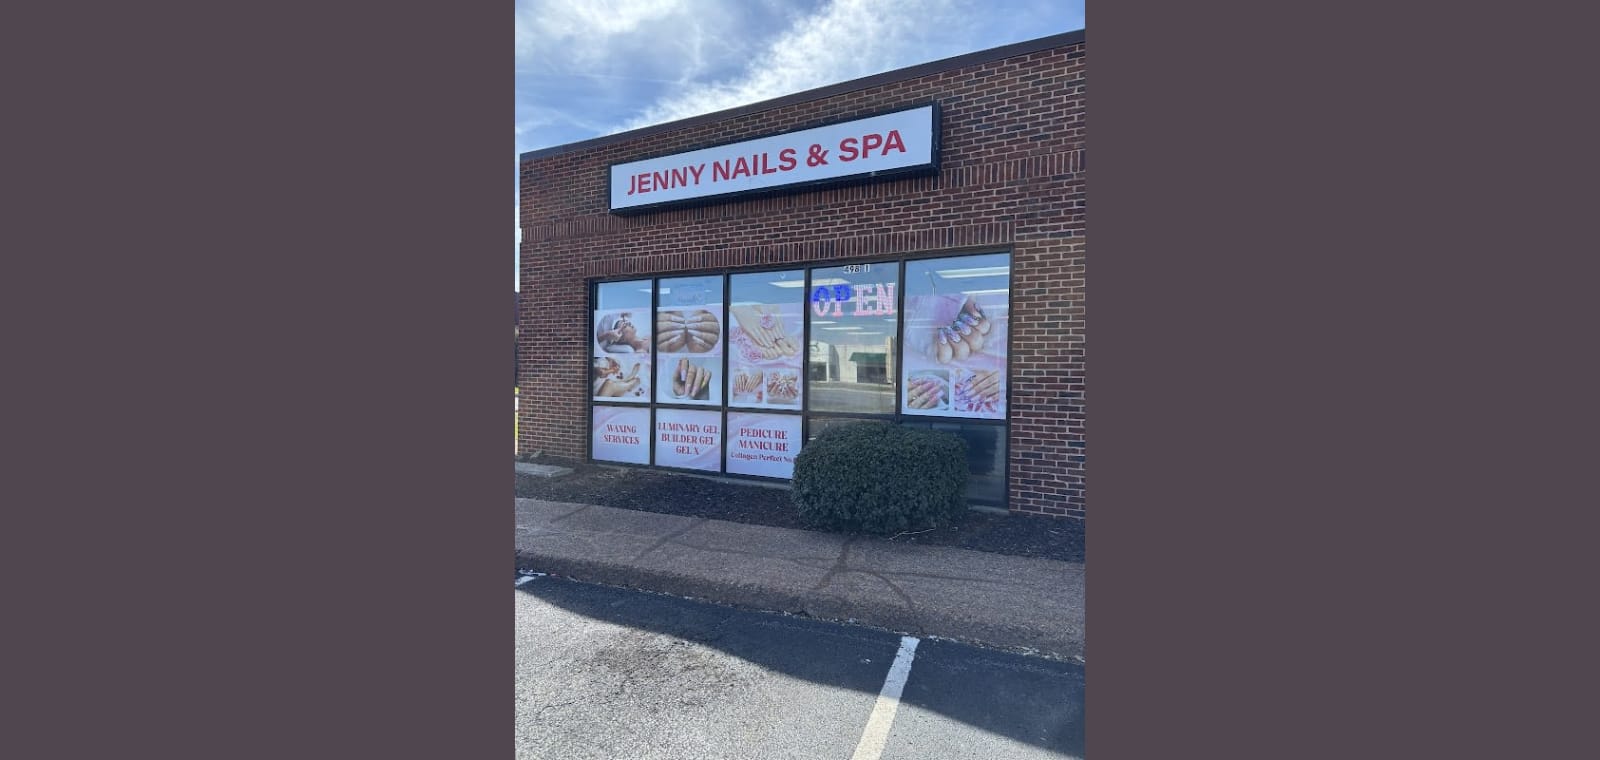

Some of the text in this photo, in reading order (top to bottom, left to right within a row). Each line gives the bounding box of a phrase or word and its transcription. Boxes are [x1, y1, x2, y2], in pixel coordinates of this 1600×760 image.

[627, 129, 906, 195] JENNY NAILS & SPA
[812, 283, 896, 317] OPEN
[606, 423, 637, 434] WAXING
[658, 422, 720, 434] LUMINARY GEL
[740, 427, 788, 440] PEDICURE
[603, 434, 640, 445] SERVICES
[661, 433, 716, 445] BUILDER GEL
[676, 445, 700, 455] GEL X
[739, 439, 789, 452] MANICURE
[731, 452, 758, 461] Collagen
[759, 454, 782, 463] Perfect
